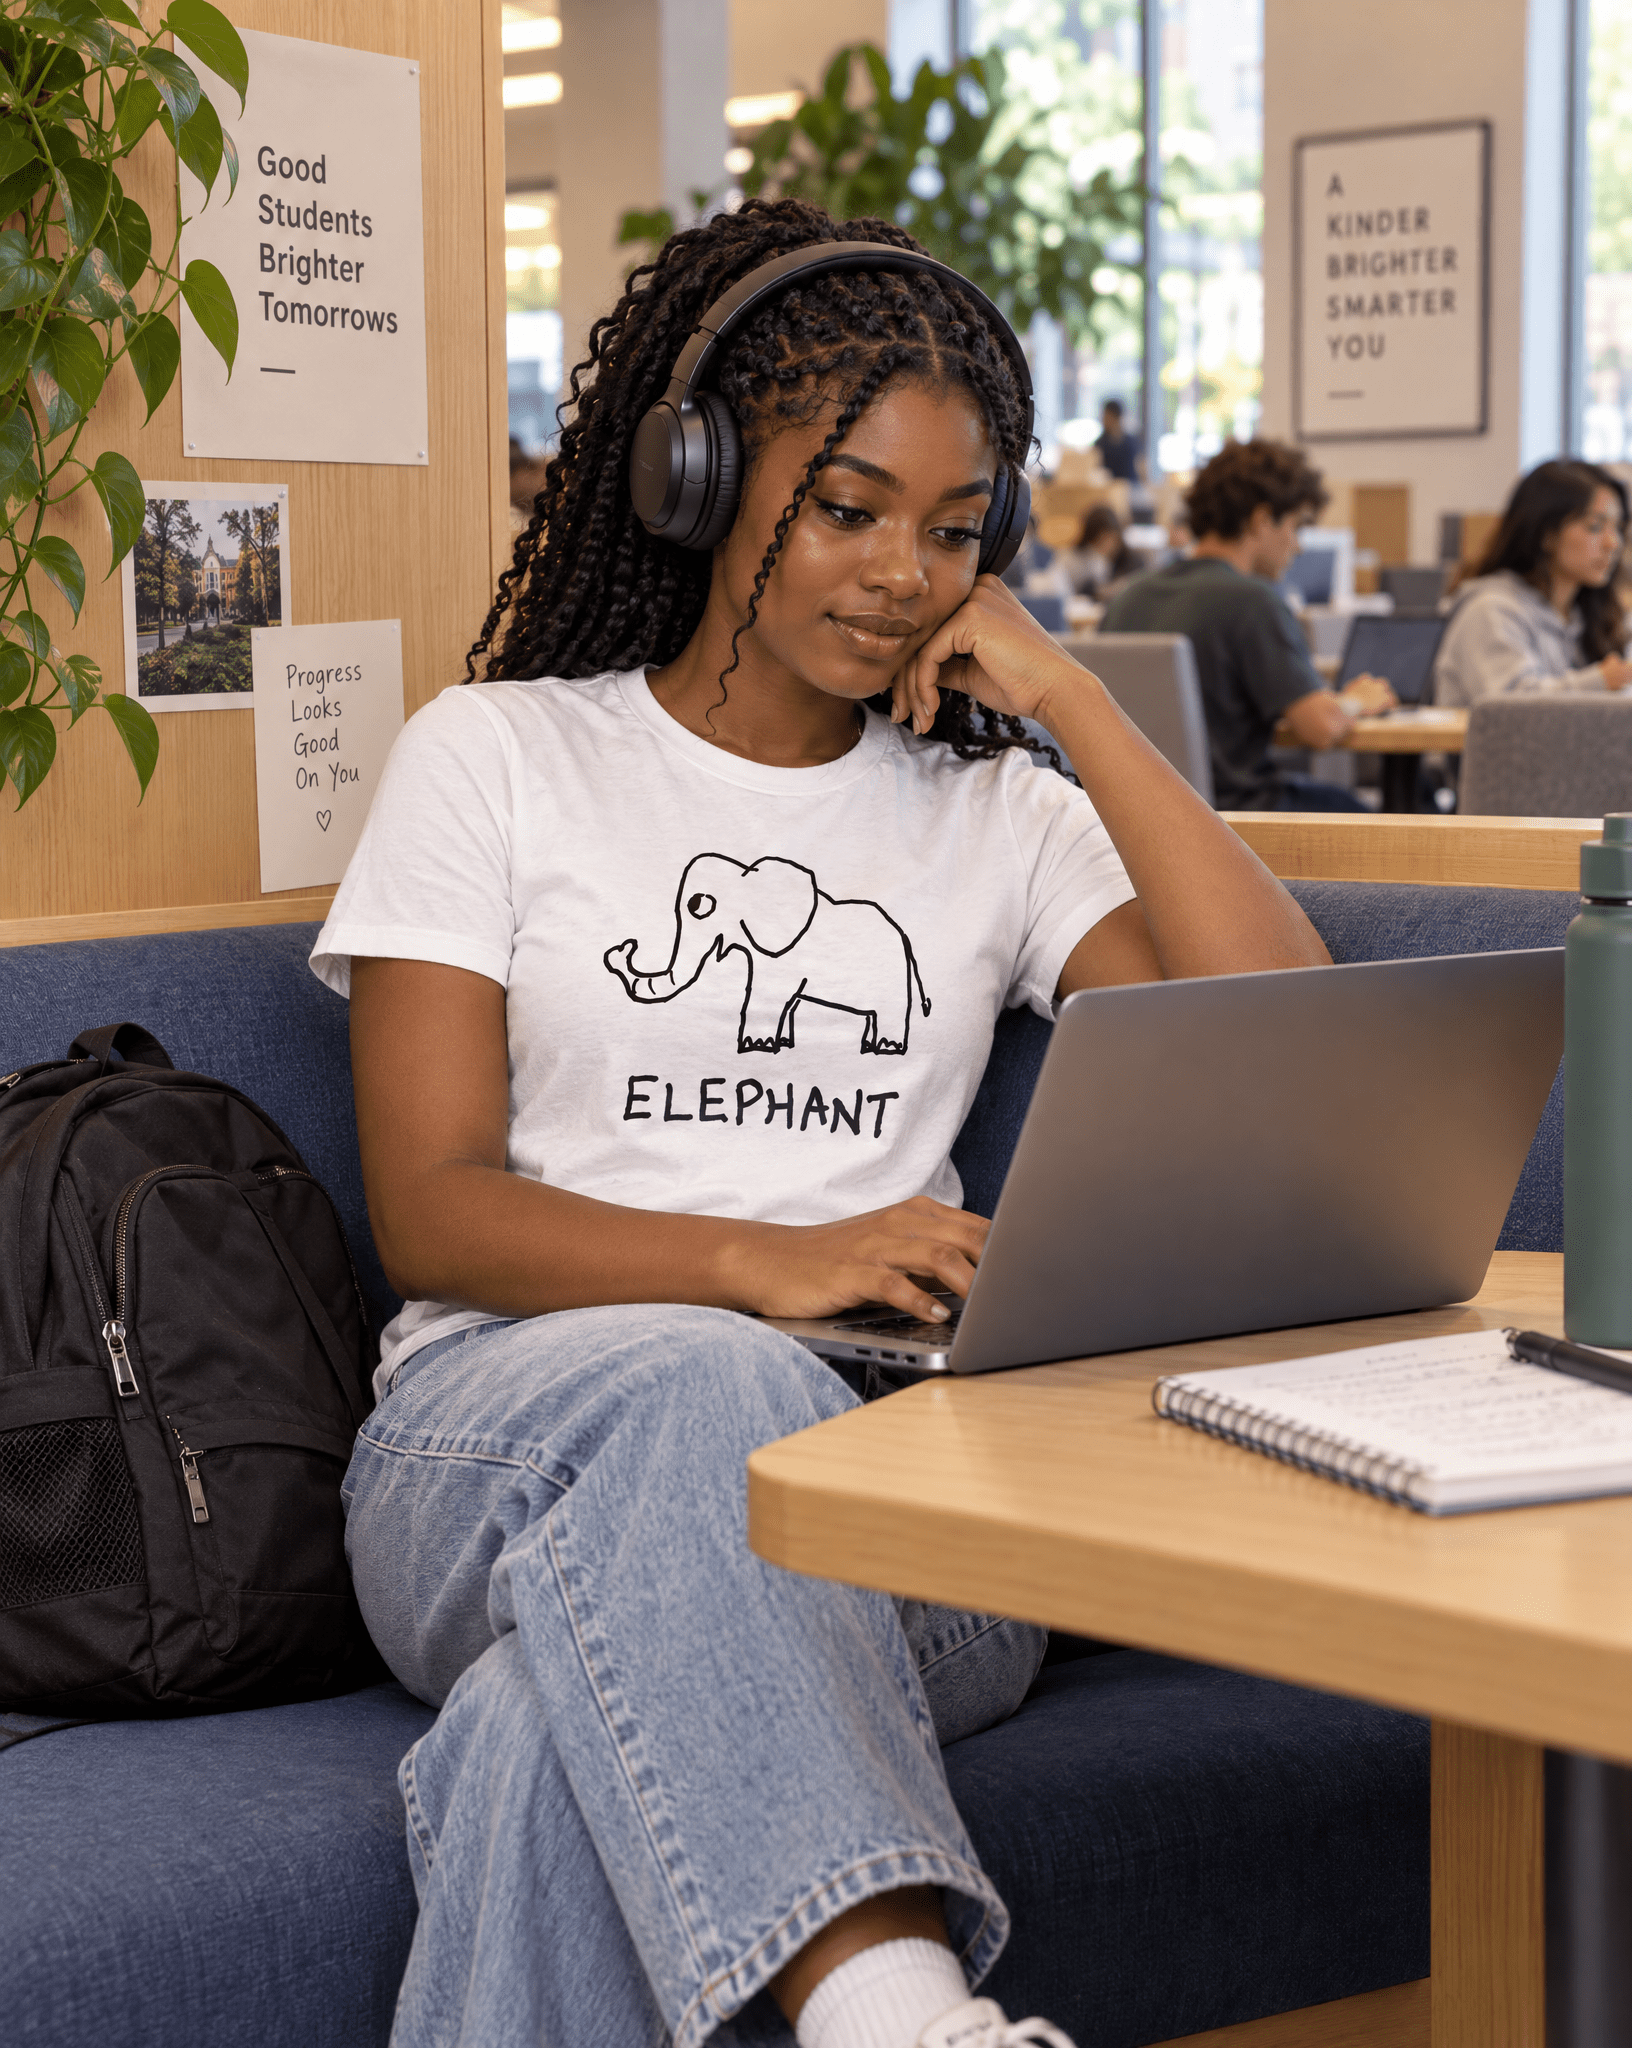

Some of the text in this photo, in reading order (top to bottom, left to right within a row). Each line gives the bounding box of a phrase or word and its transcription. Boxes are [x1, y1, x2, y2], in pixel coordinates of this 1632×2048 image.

[257, 145, 327, 185] Good
[1327, 174, 1344, 197] A
[257, 193, 373, 239] Students
[1327, 207, 1430, 238] KINDER
[259, 242, 365, 286] Brighter
[1327, 247, 1457, 279] BRIGHTER
[258, 290, 398, 334] Tomorrows
[1327, 288, 1456, 321] SMARTER
[1328, 333, 1385, 361] YOU
[285, 663, 362, 695] Progress
[291, 695, 342, 723] Looks
[293, 727, 340, 759] Good
[295, 761, 361, 791] On You
[623, 1074, 900, 1139] ELEPHANT
